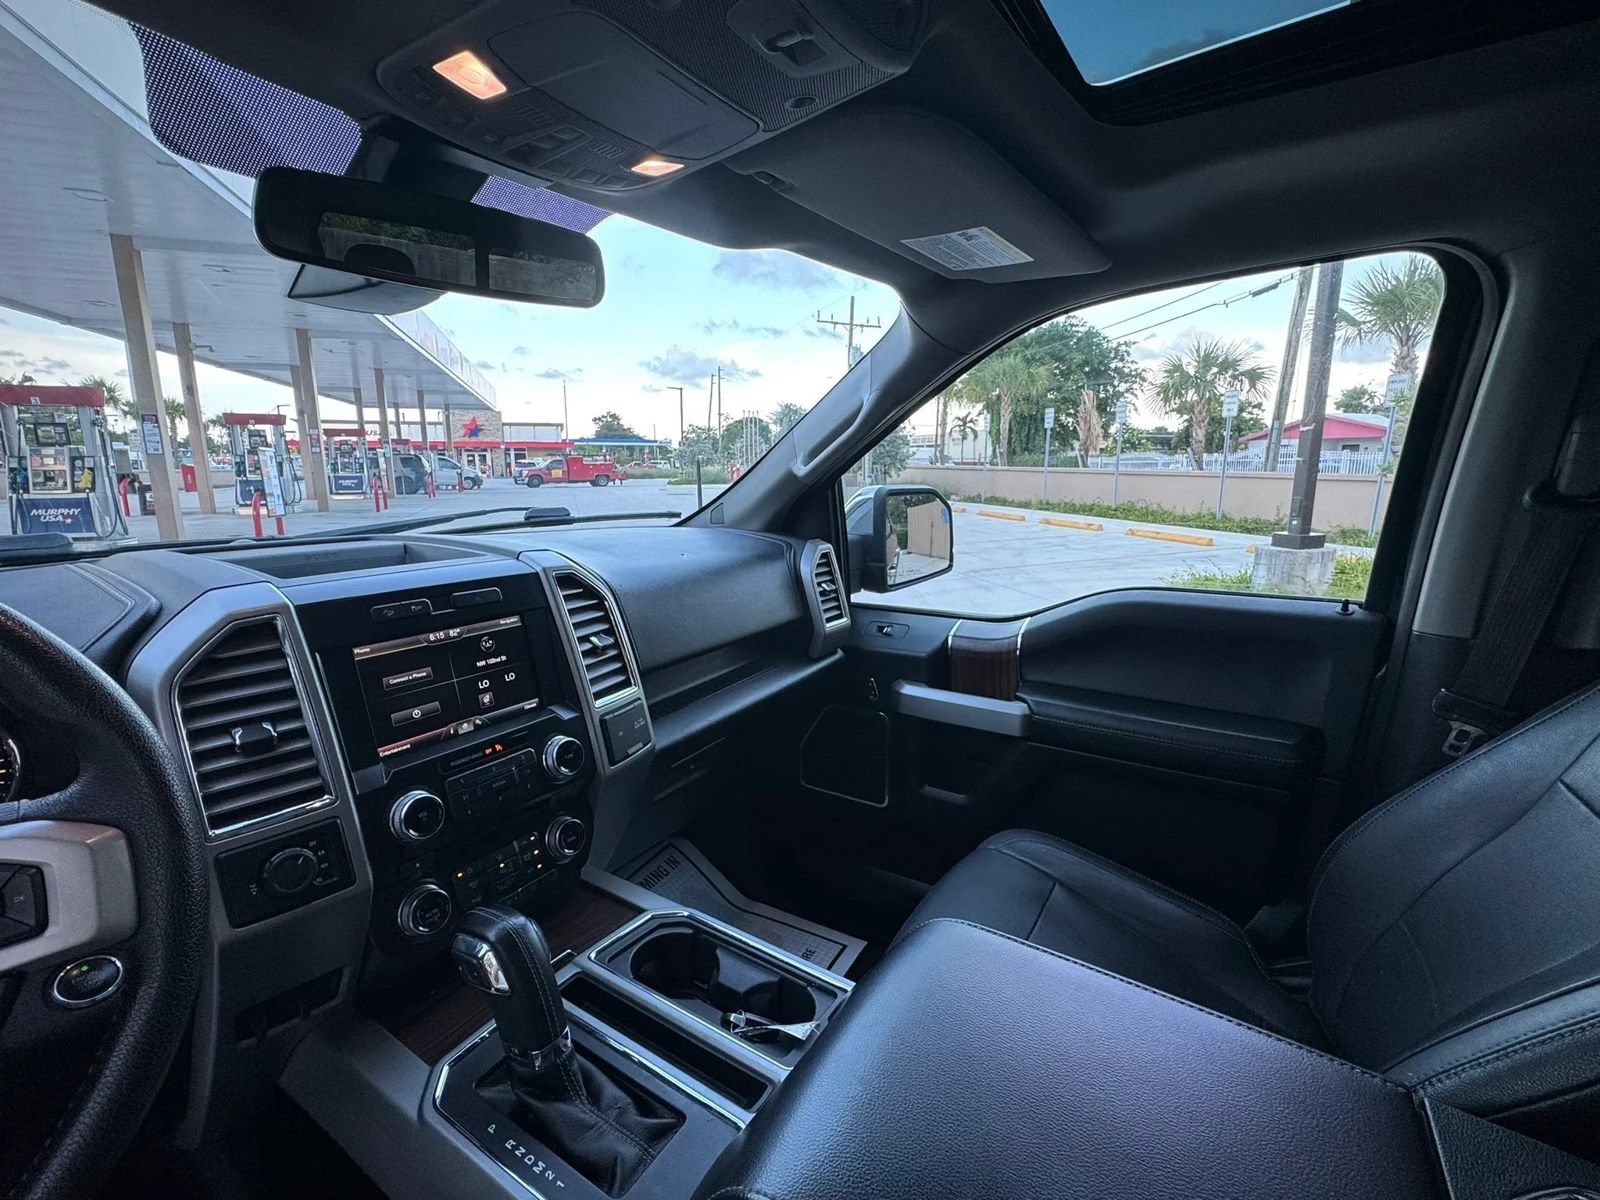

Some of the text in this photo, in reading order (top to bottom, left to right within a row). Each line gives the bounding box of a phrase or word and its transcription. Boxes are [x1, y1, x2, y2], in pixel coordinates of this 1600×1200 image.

[30, 508, 81, 516] MURPHY
[429, 632, 445, 641] 6:15
[478, 672, 516, 689] LO LO
[664, 855, 681, 870] IN
[487, 1124, 496, 1134] P
[505, 1139, 517, 1150] R
[524, 1154, 535, 1165] D
